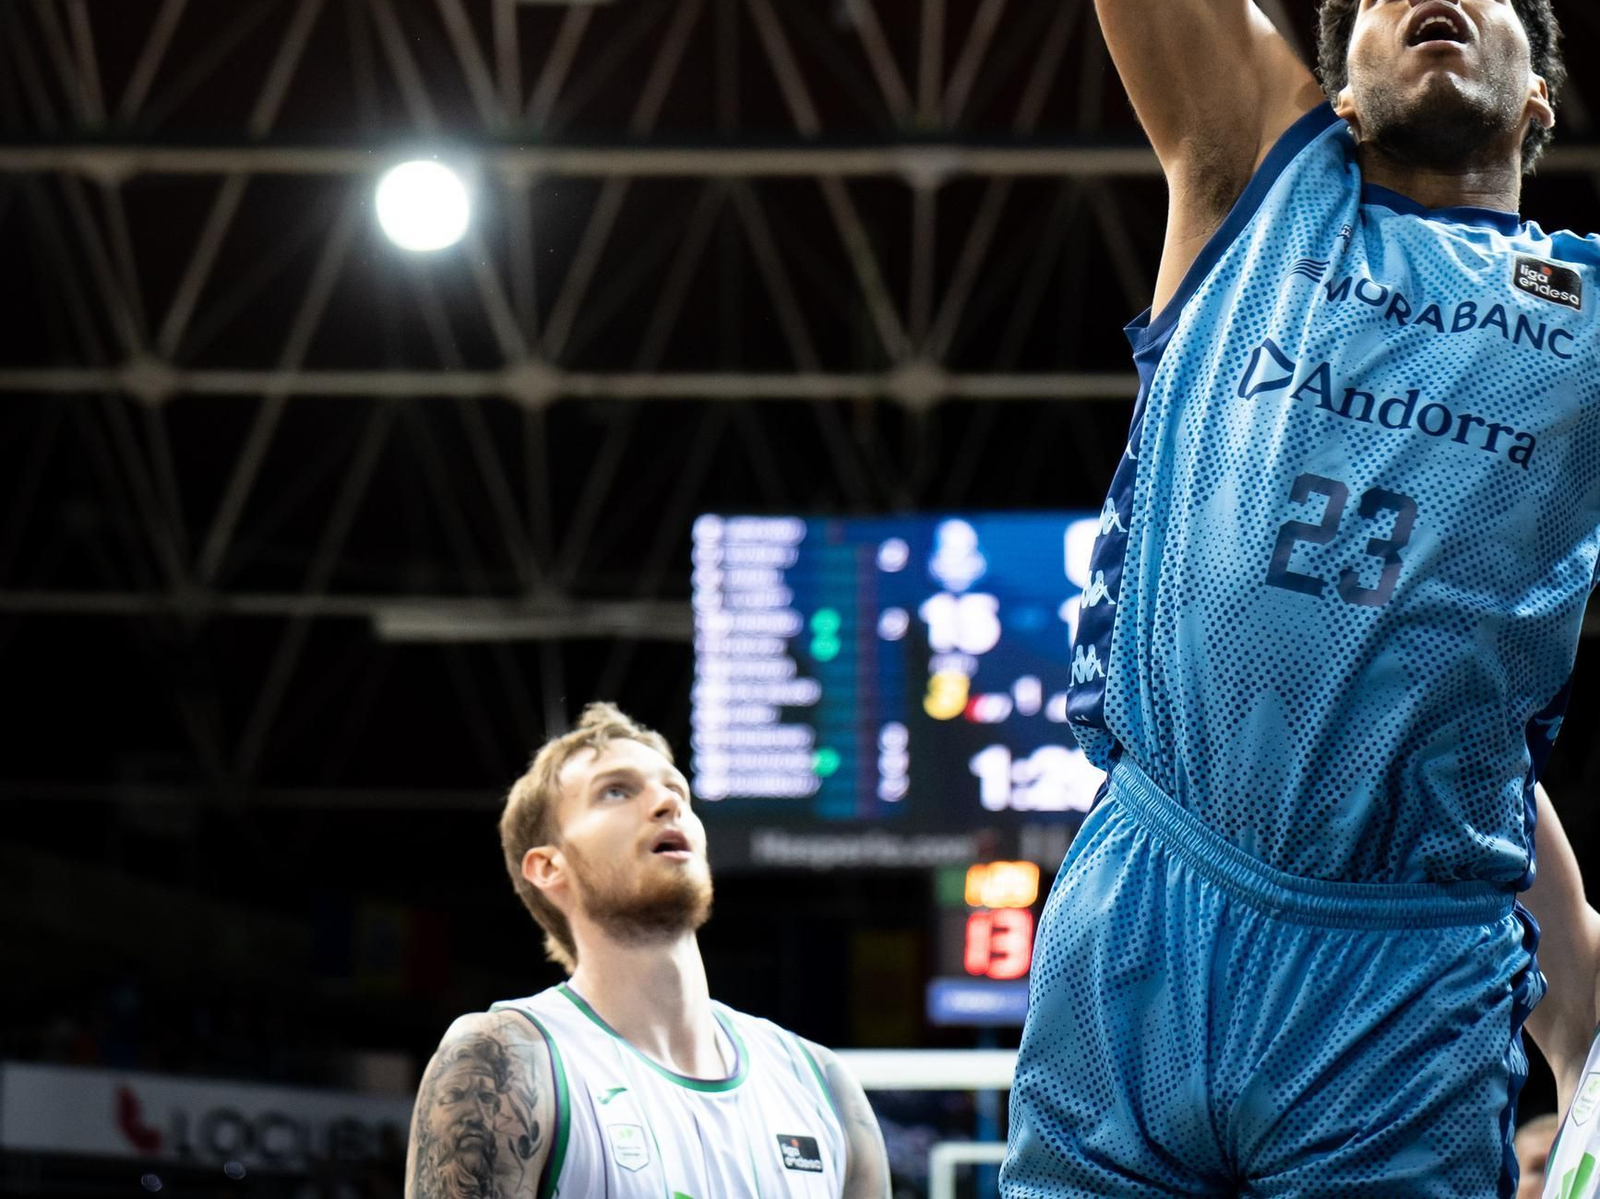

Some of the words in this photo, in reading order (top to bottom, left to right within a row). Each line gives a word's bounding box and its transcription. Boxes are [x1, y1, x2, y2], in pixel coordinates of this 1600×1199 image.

[1519, 277, 1580, 305] endesa
[1520, 264, 1549, 283] liga
[1324, 276, 1574, 360] MORABANC
[1289, 361, 1537, 471] Andorra
[1264, 471, 1420, 608] 23
